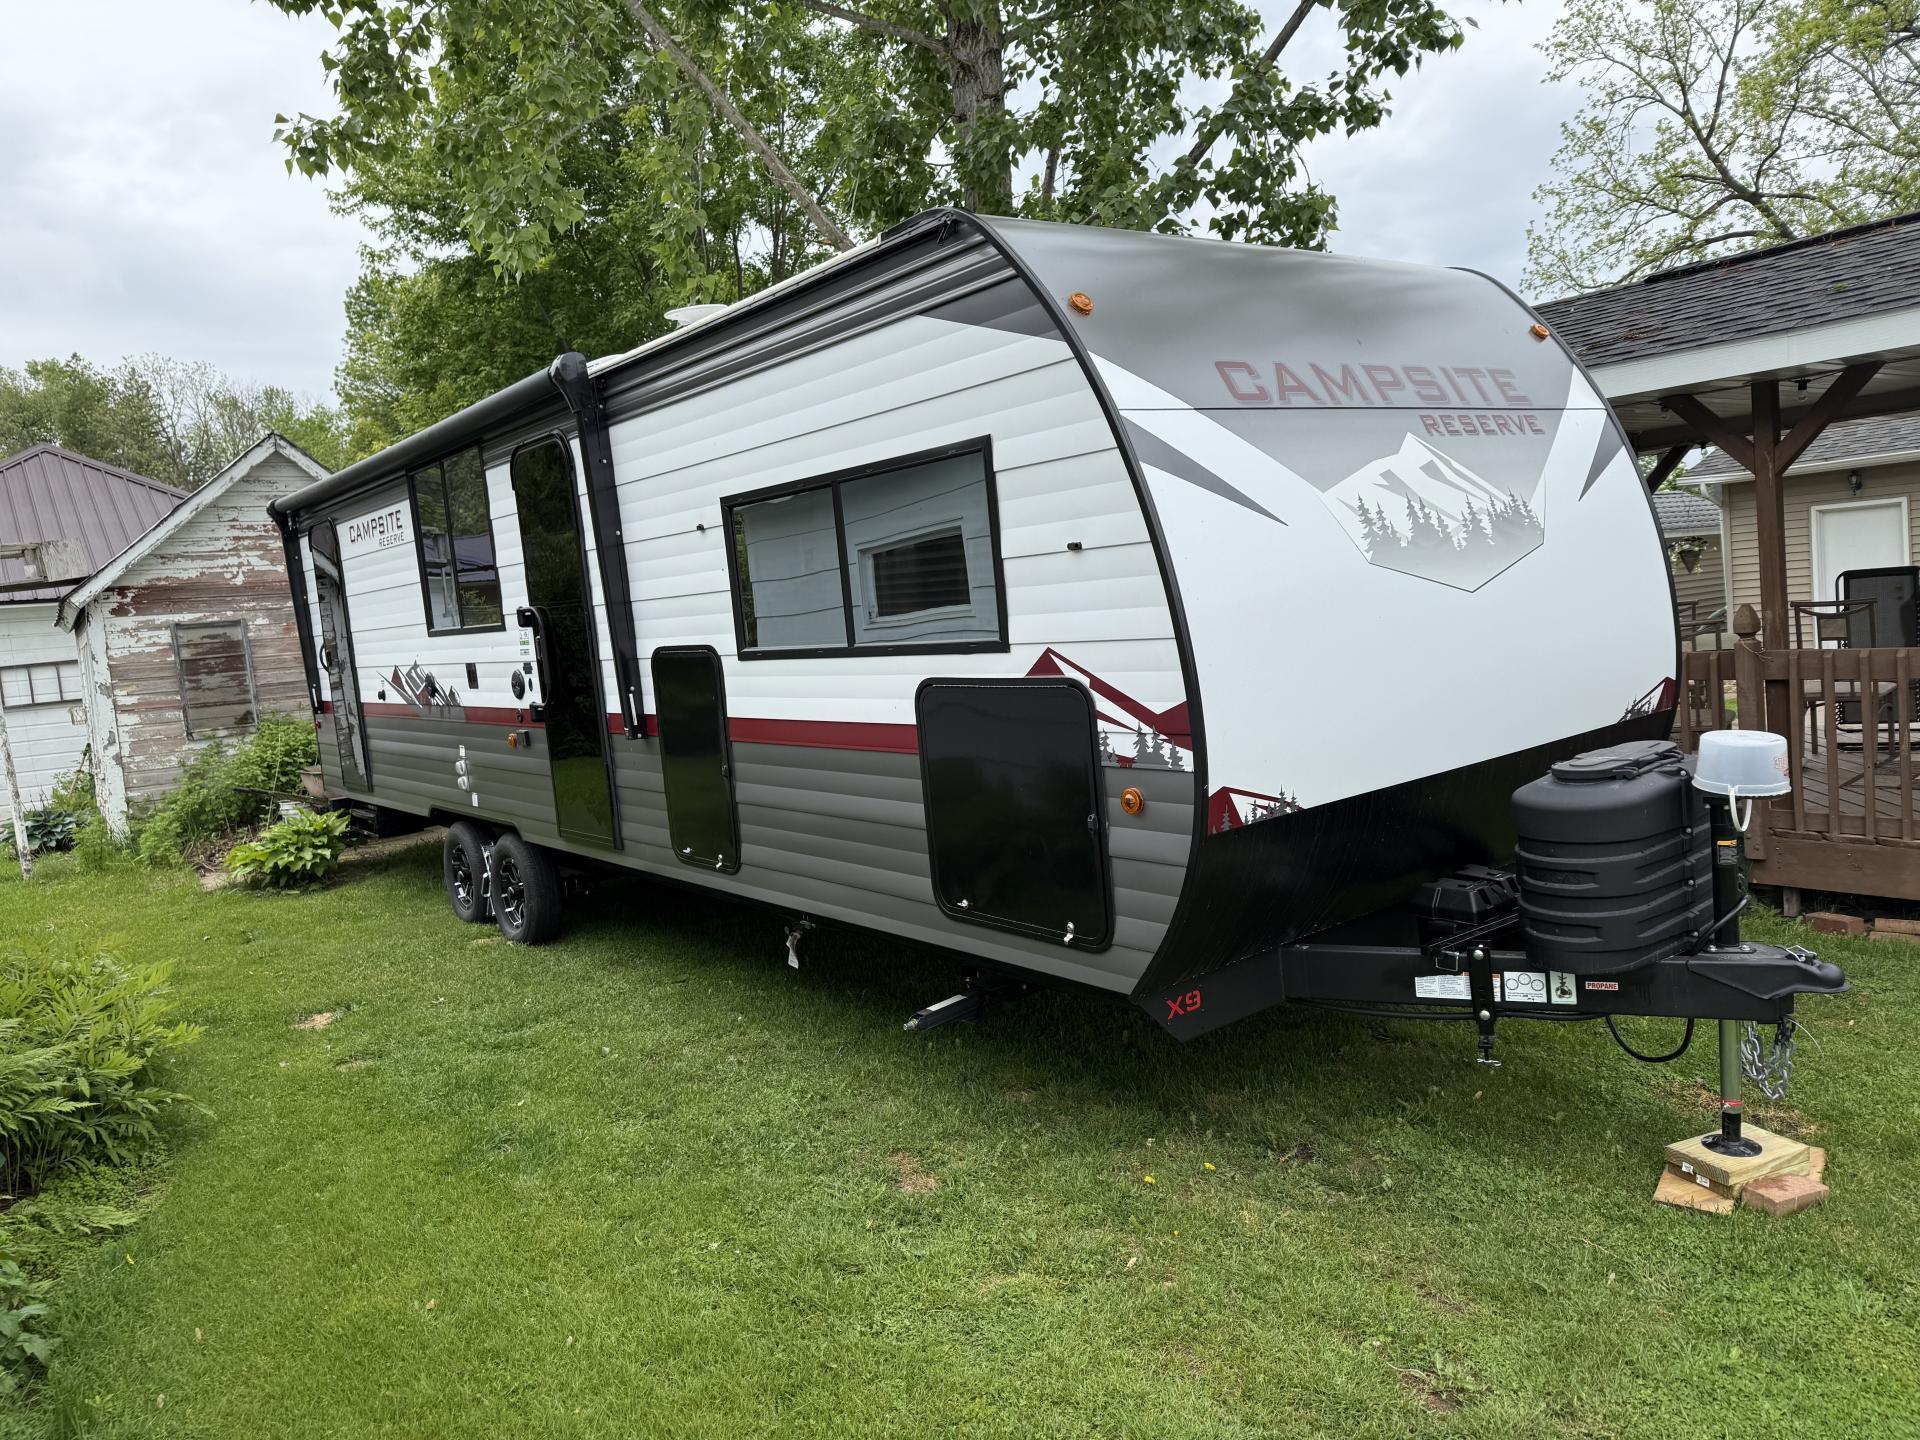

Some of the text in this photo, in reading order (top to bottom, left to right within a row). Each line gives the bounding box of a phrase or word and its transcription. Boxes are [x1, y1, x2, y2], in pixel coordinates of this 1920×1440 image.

[1214, 360, 1534, 405] CAMPSITE
[1420, 414, 1545, 436] RESERVE
[349, 510, 402, 543] CAMPSITE
[379, 532, 404, 547] RESERVE
[1587, 982, 1618, 990] PROPANE
[1167, 990, 1200, 1020] X9
